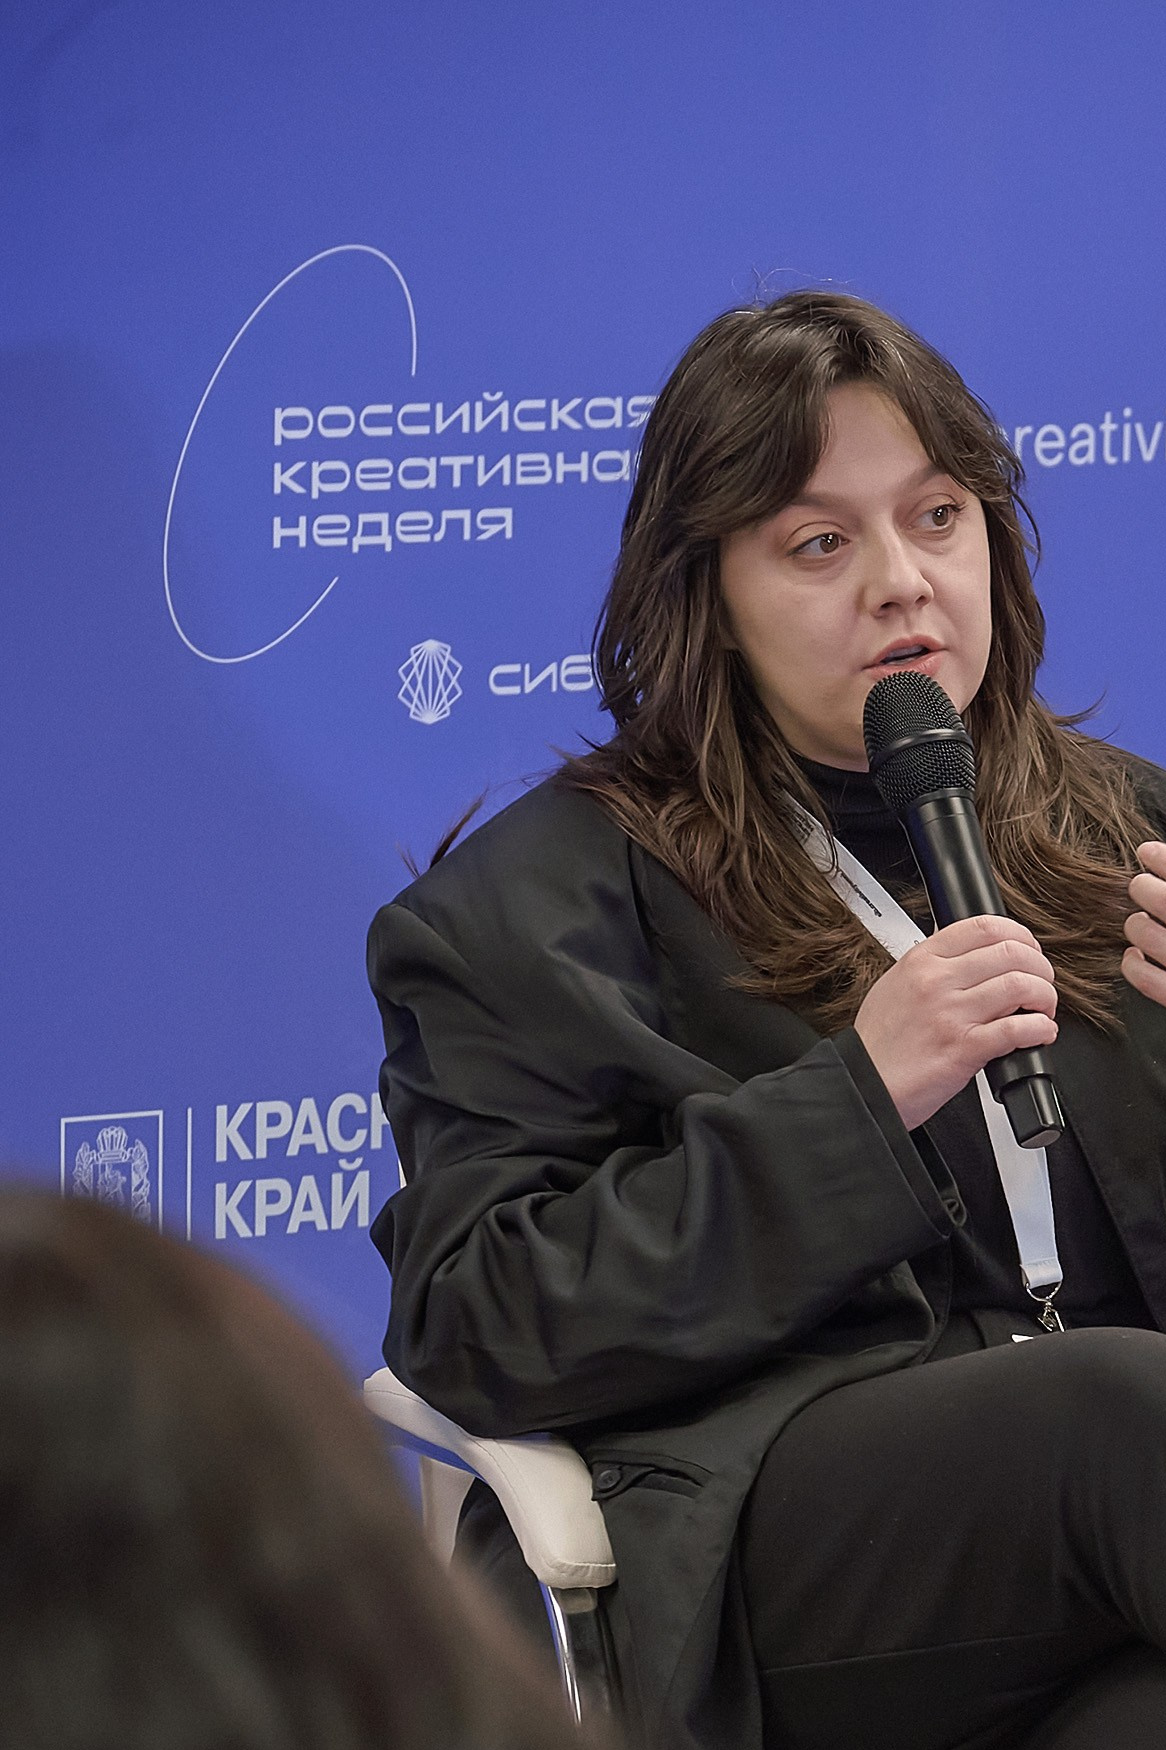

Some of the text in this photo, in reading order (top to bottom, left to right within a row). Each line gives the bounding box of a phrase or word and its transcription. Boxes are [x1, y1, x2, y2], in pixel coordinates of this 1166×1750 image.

[272, 391, 659, 445] российская
[272, 449, 642, 499] креативна
[272, 507, 513, 553] неделя
[488, 653, 596, 696] сиб
[215, 1156, 370, 1240] КРАЙ
